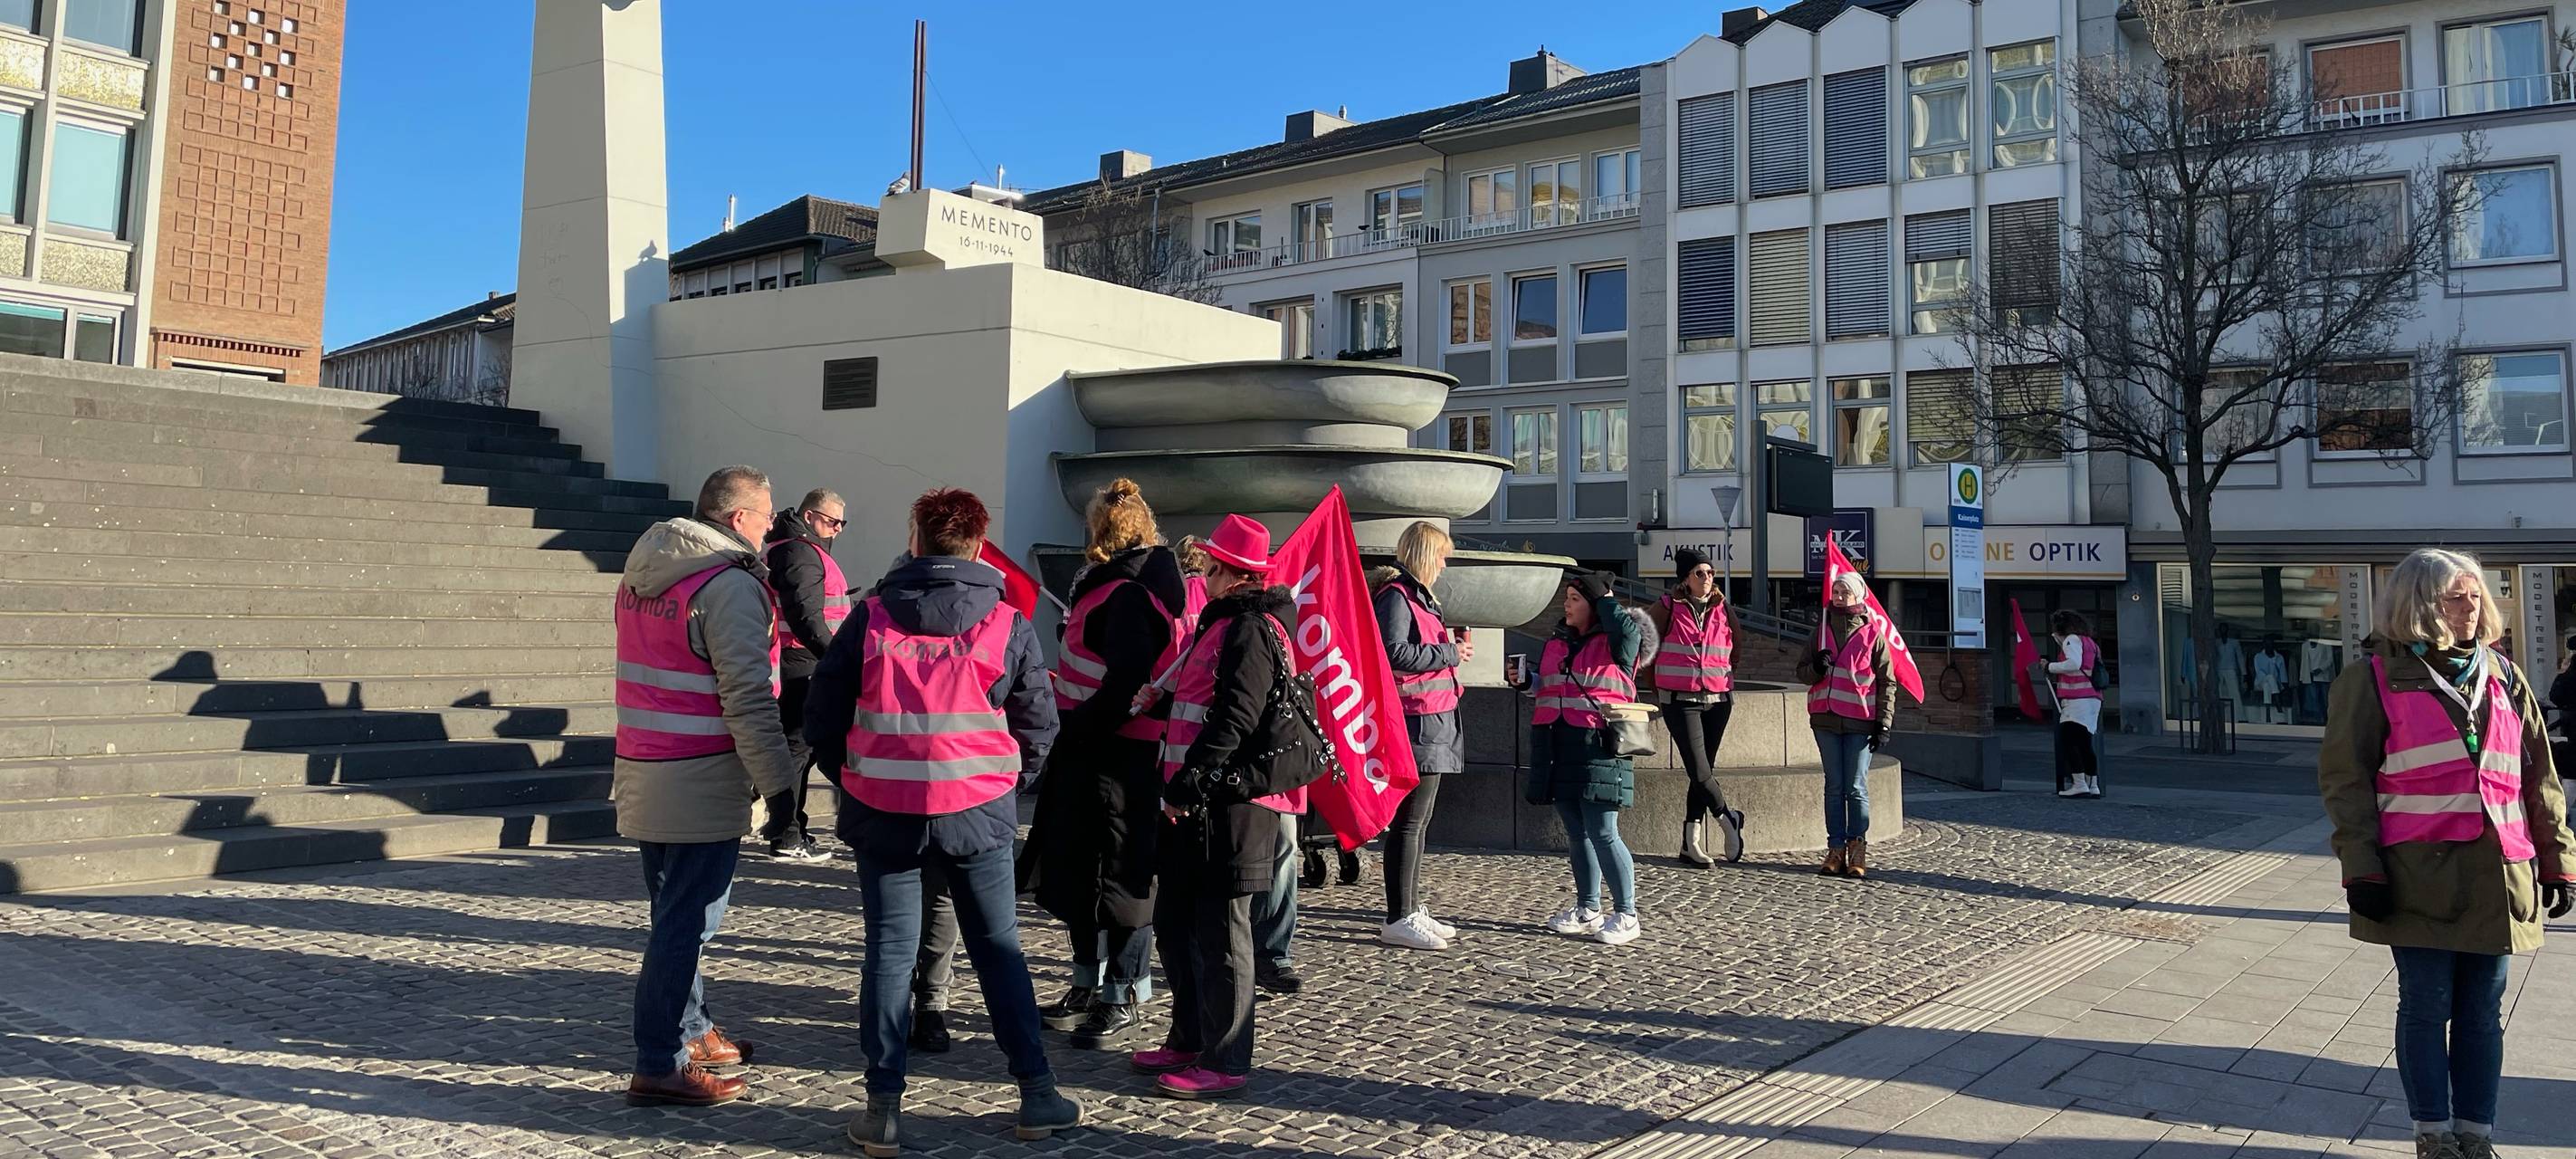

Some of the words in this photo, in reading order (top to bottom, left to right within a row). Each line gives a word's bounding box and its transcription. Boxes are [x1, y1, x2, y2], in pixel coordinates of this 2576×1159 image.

[941, 205, 1032, 241] MEMENTO
[1964, 475, 1973, 496] H
[2029, 542, 2102, 561] OPTIK
[1290, 563, 1391, 795] komba
